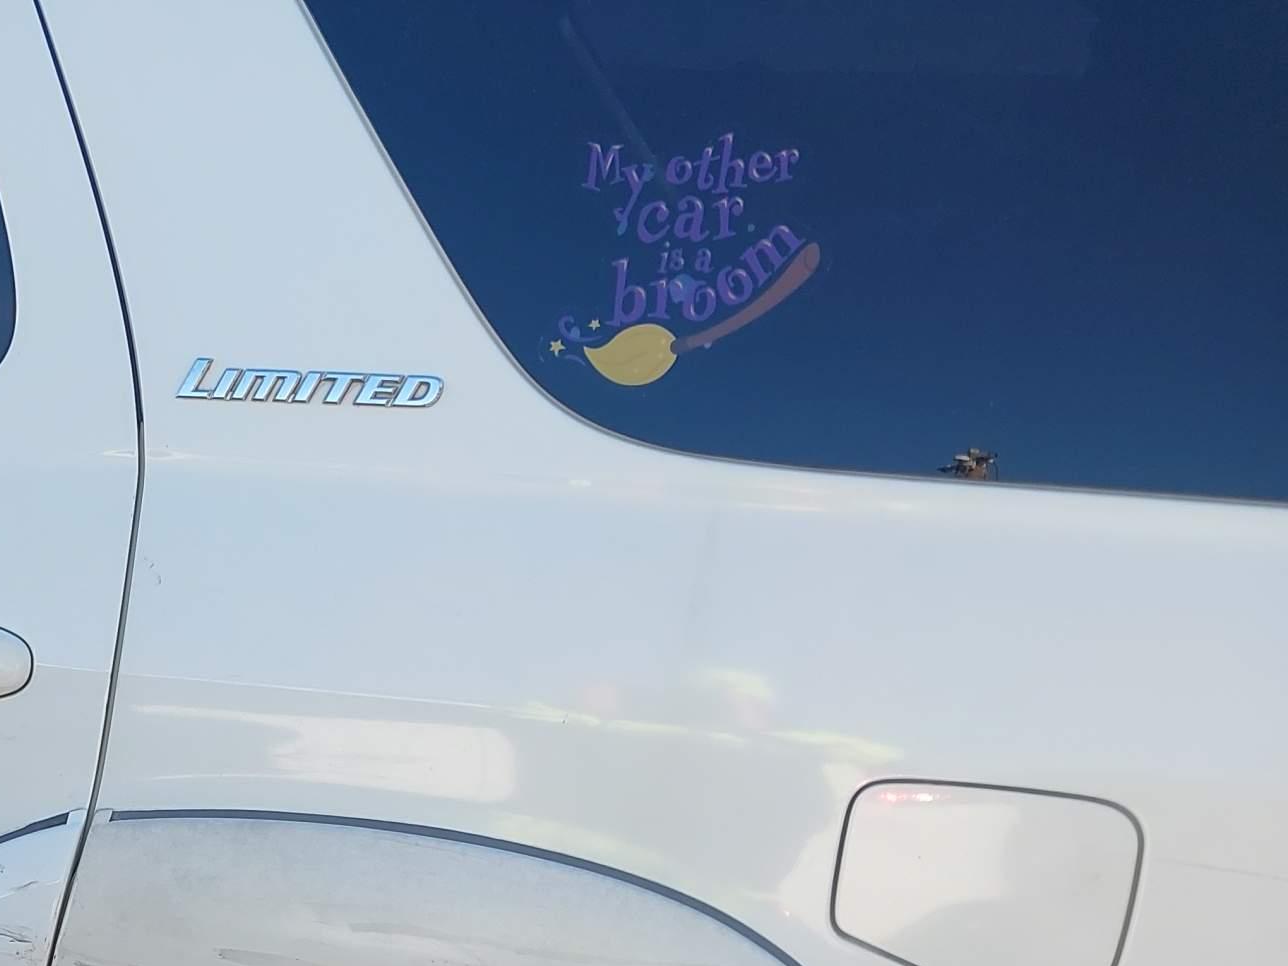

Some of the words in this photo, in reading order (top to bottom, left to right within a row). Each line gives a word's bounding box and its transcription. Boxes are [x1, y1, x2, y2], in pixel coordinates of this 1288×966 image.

[581, 141, 654, 232] My
[665, 132, 800, 194] other
[636, 195, 744, 244] car
[605, 223, 806, 328] broom
[658, 241, 685, 274] is
[694, 248, 713, 274] a
[176, 357, 445, 408] LIMITED
